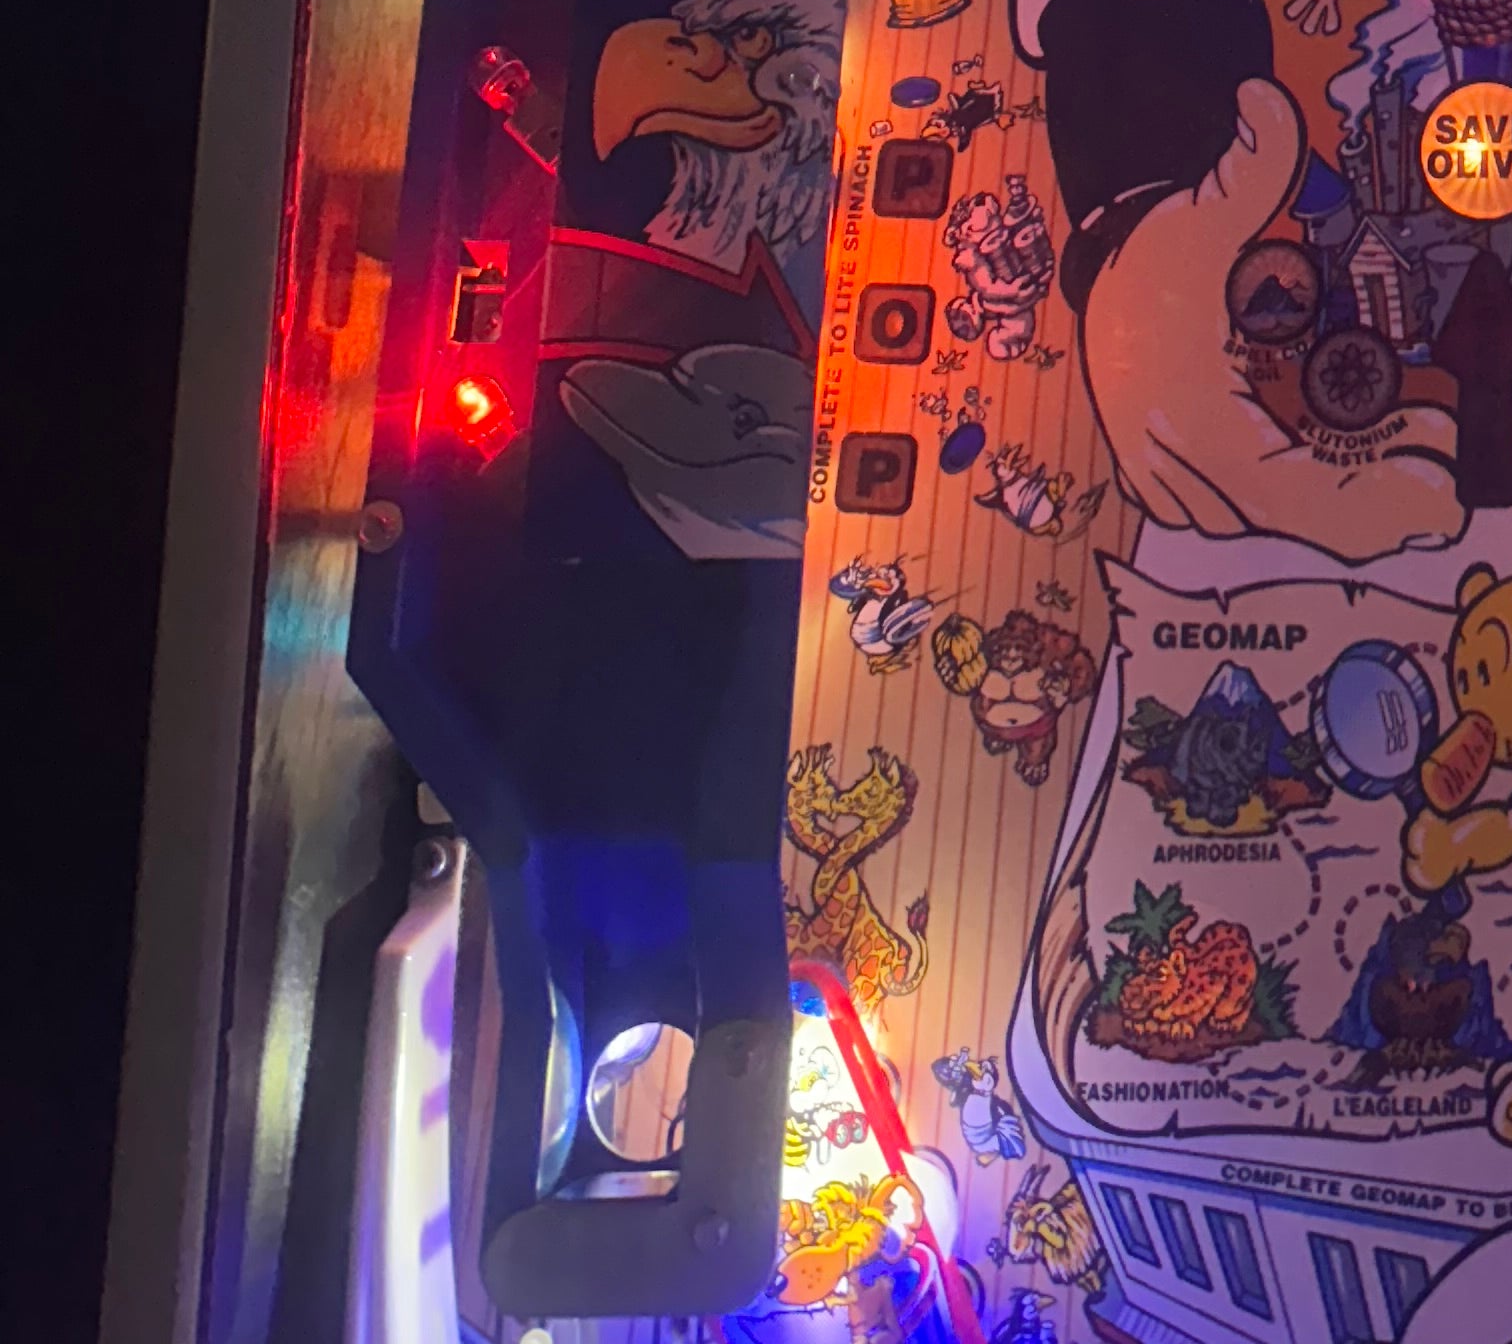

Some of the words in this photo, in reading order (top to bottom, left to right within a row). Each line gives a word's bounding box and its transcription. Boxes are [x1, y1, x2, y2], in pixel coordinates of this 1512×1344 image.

[843, 144, 873, 252] SPINACH
[891, 154, 935, 201] P
[835, 259, 857, 315] LITE
[828, 327, 848, 359] TO
[870, 298, 918, 350] O
[810, 368, 843, 505] COMPLETE
[1311, 445, 1378, 467] WASTE
[856, 447, 901, 500] P
[1153, 622, 1308, 651] GEOMAP
[1153, 842, 1282, 863] APHRODESIA
[1076, 1079, 1230, 1103] FASHIONATION
[1333, 1096, 1473, 1118] L'EAGLELAND
[1221, 1163, 1342, 1197] COMPLETE
[1350, 1183, 1446, 1211] GEOMAP
[1455, 1199, 1486, 1218] TO
